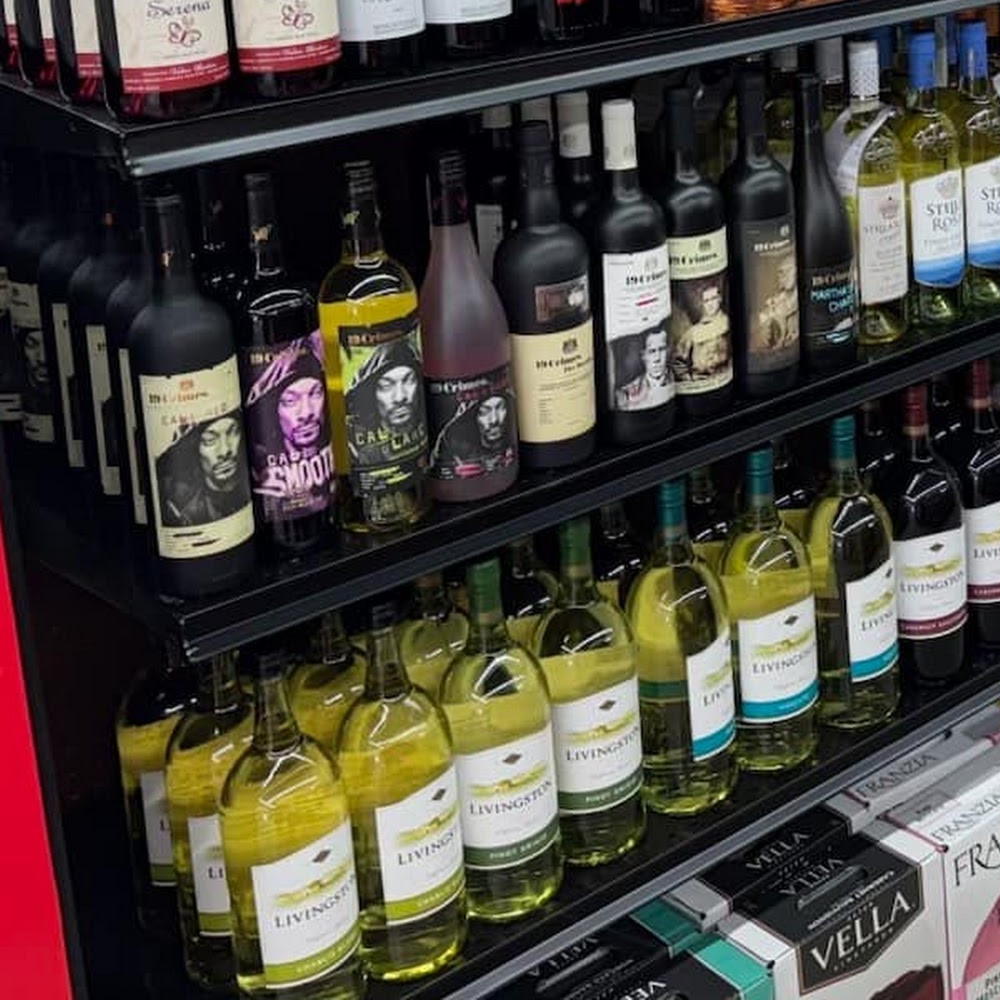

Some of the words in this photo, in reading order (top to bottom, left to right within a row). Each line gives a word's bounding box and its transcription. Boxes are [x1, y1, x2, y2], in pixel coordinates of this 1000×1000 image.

[147, 0, 210, 18] Serena
[857, 753, 938, 799] FRANZIA
[470, 780, 552, 815] LIVINGSTON
[811, 890, 911, 970] VELLA
